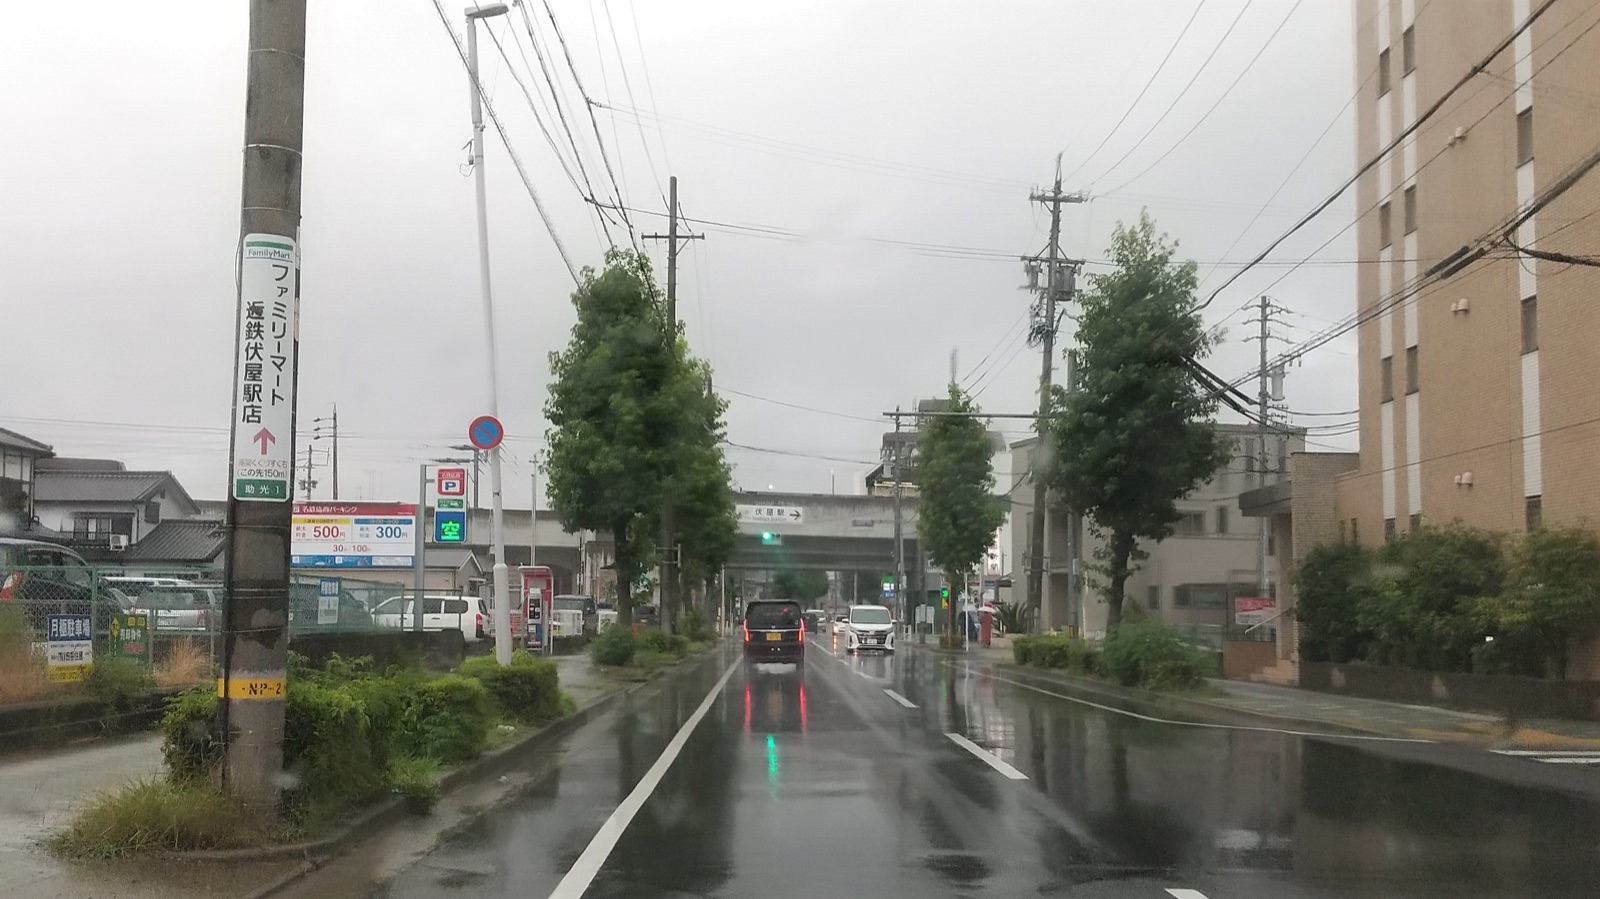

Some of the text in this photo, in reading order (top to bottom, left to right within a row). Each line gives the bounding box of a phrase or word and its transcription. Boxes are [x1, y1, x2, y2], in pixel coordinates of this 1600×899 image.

[248, 249, 290, 259] FamilyMart
[270, 264, 289, 406] ファミリーマート
[444, 481, 457, 491] P
[755, 508, 785, 516] 伏屋駅
[441, 521, 460, 540] 空
[50, 618, 90, 637] 月極駐車場
